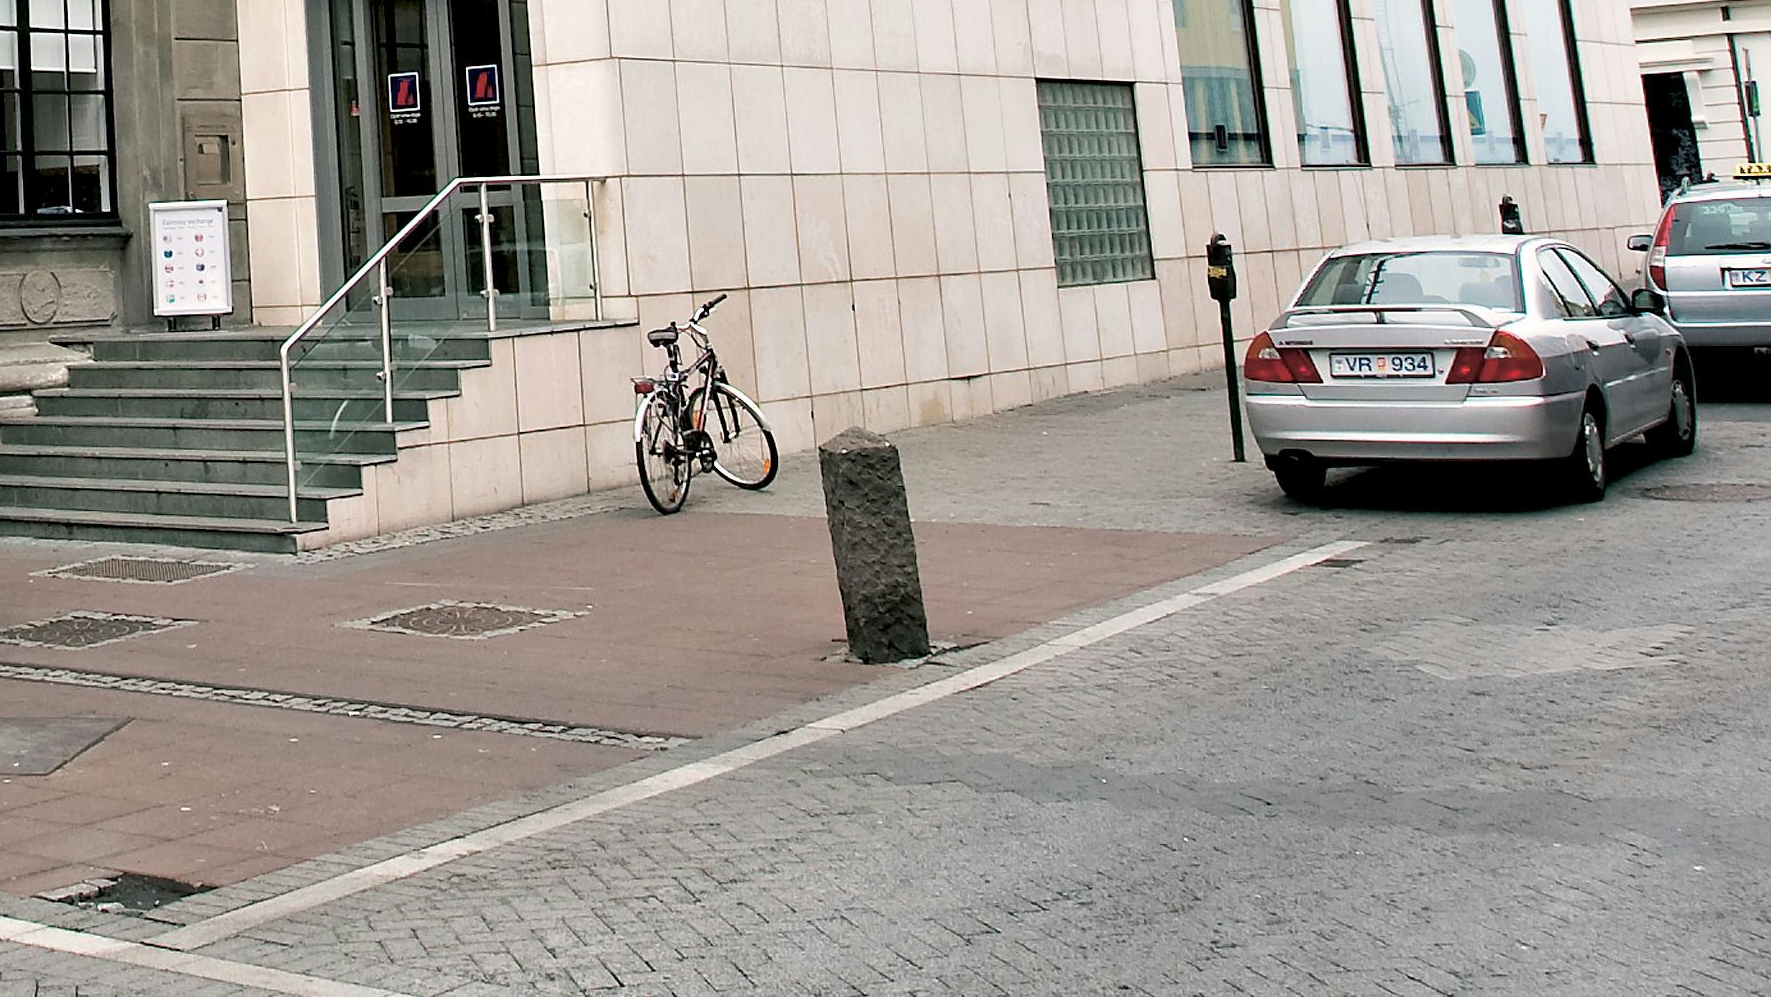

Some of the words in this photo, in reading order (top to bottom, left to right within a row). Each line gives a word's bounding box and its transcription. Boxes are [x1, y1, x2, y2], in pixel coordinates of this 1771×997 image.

[1742, 270, 1767, 283] KZ
[1345, 356, 1373, 372] VR
[1391, 356, 1429, 372] 934
